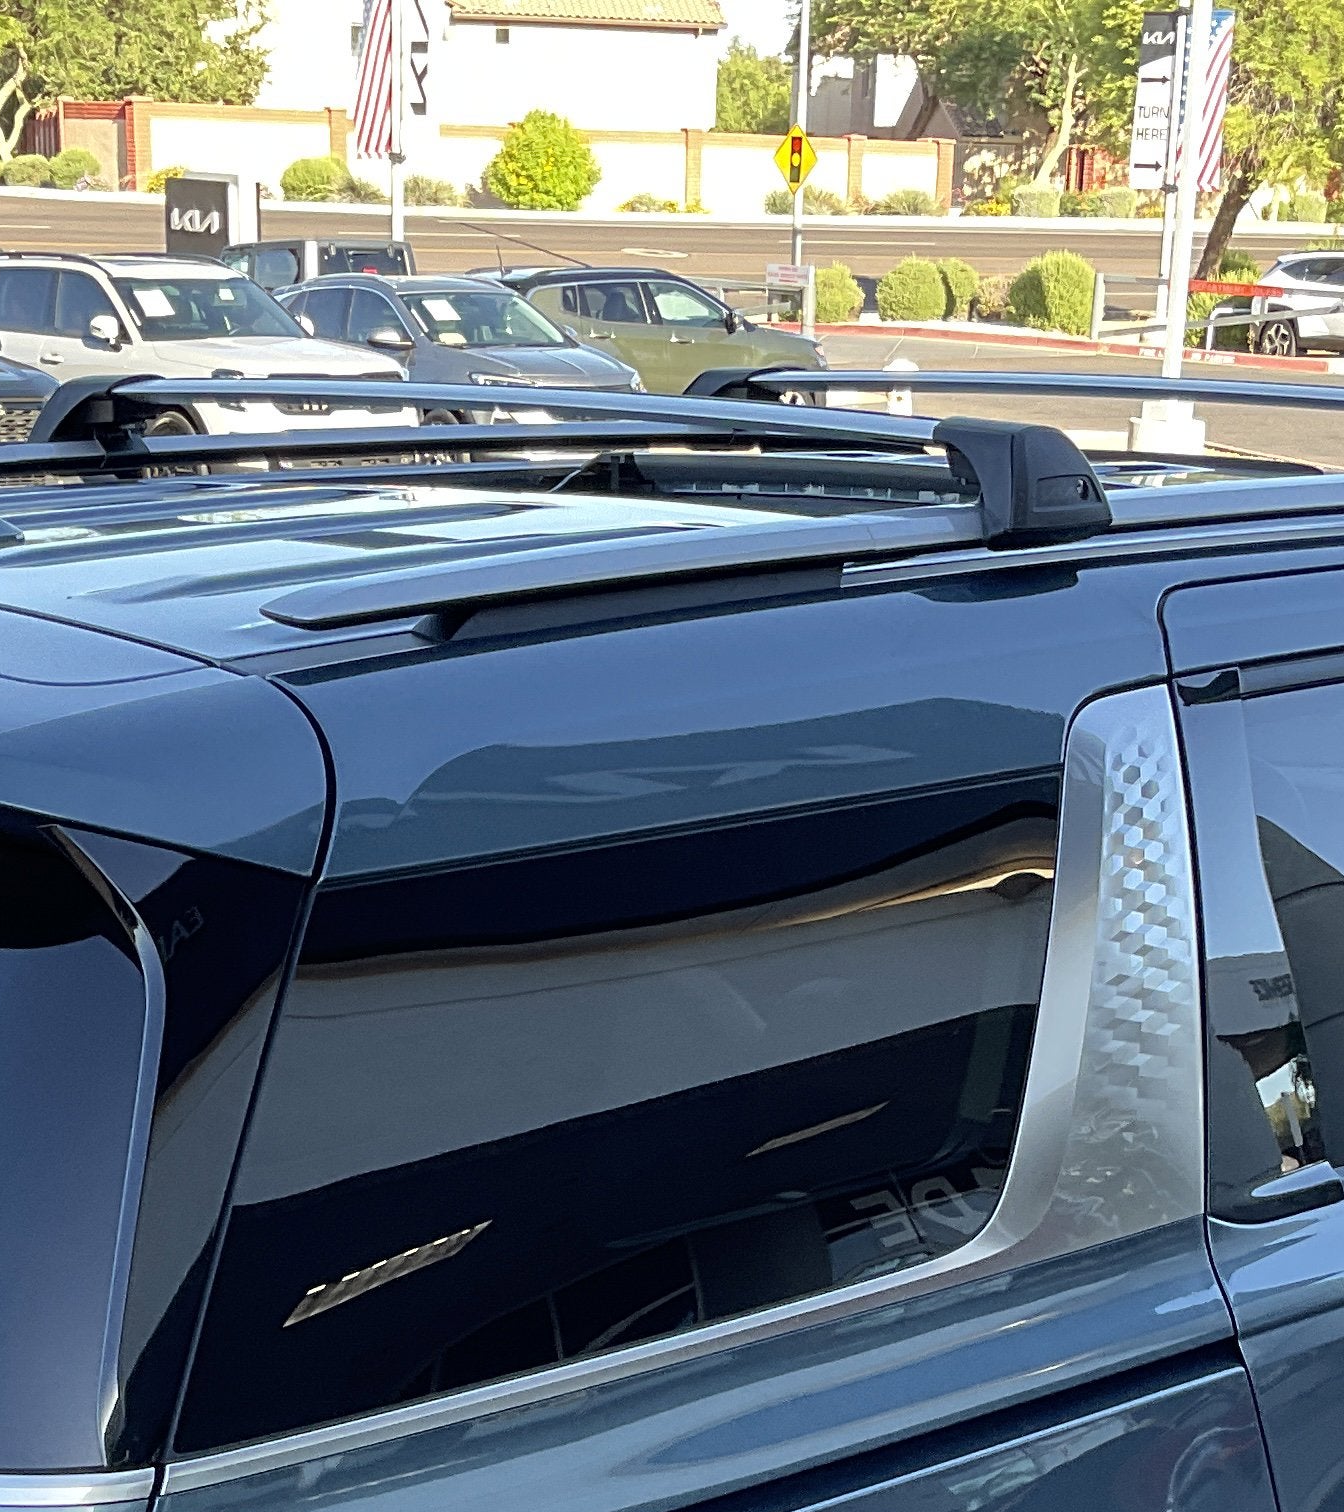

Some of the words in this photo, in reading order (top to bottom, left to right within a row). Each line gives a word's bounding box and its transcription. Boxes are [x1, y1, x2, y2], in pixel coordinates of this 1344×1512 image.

[1142, 31, 1176, 45] KIA
[1137, 106, 1169, 119] TURN
[1136, 128, 1167, 140] HERE
[170, 207, 220, 235] KIA
